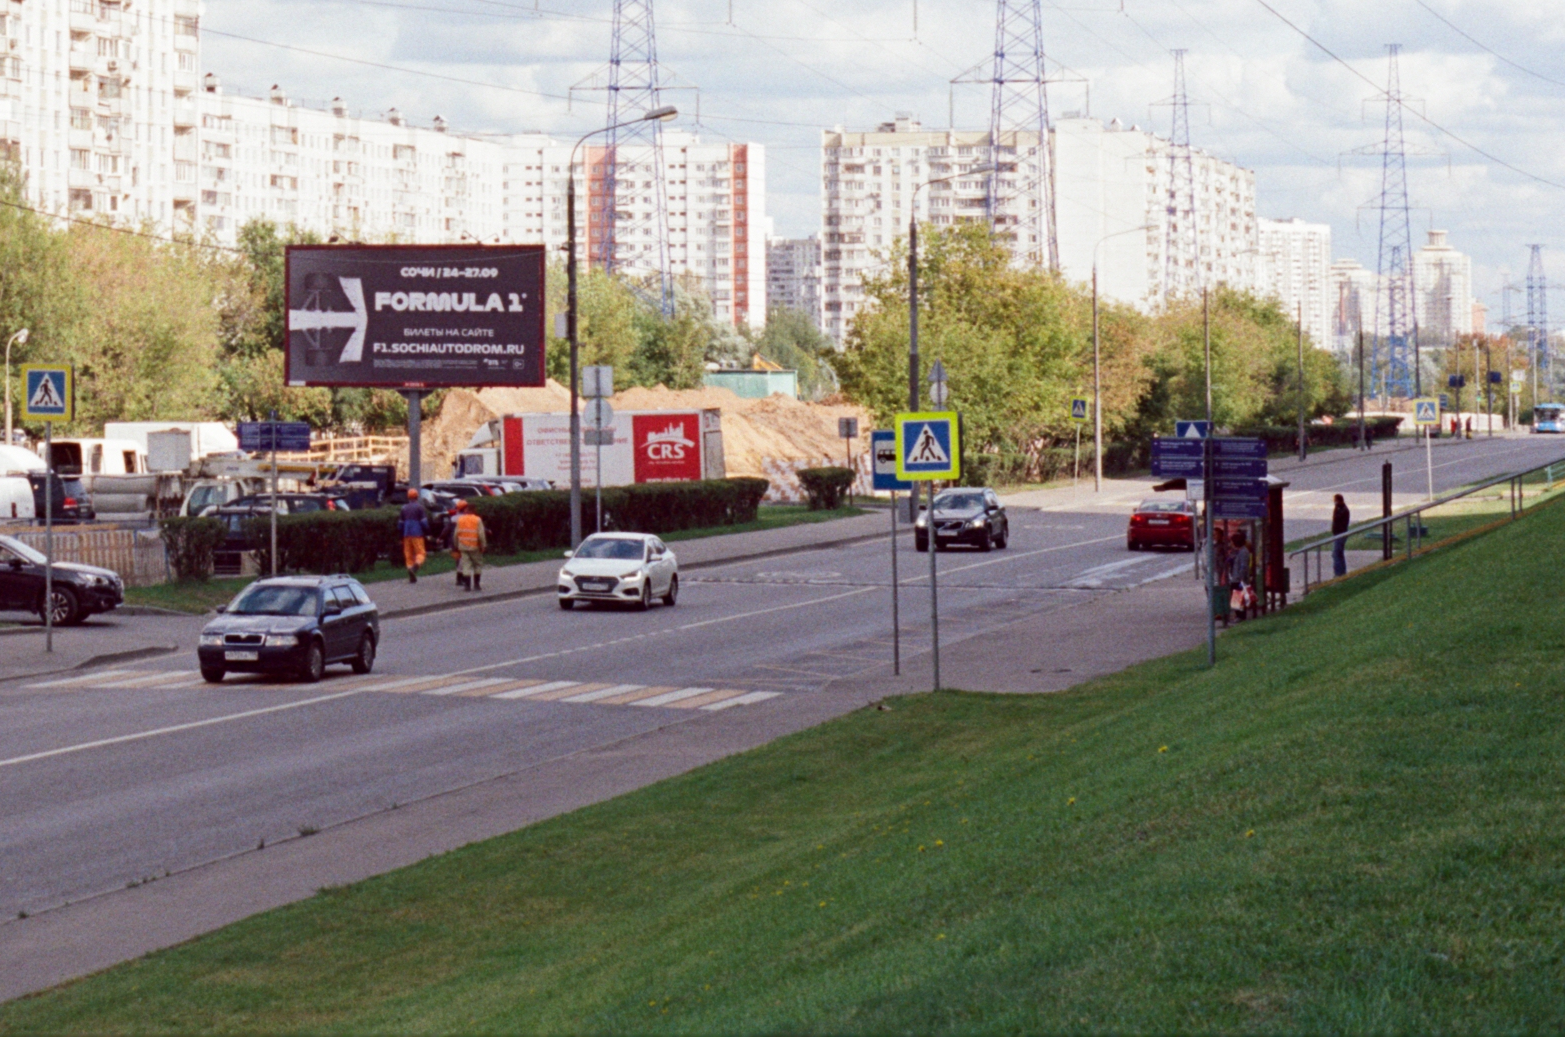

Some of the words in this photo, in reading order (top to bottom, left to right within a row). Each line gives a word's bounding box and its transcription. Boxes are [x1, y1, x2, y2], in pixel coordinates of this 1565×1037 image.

[400, 266, 435, 278] СОЧИ
[374, 292, 504, 312] FORMULA
[404, 328, 443, 337] БИЛЕТЫ
[445, 328, 459, 337] НА
[461, 327, 494, 337] САЙТЕ
[373, 343, 524, 354] F1.SOCHIAUTODROM.RU
[646, 443, 685, 460] CRS
